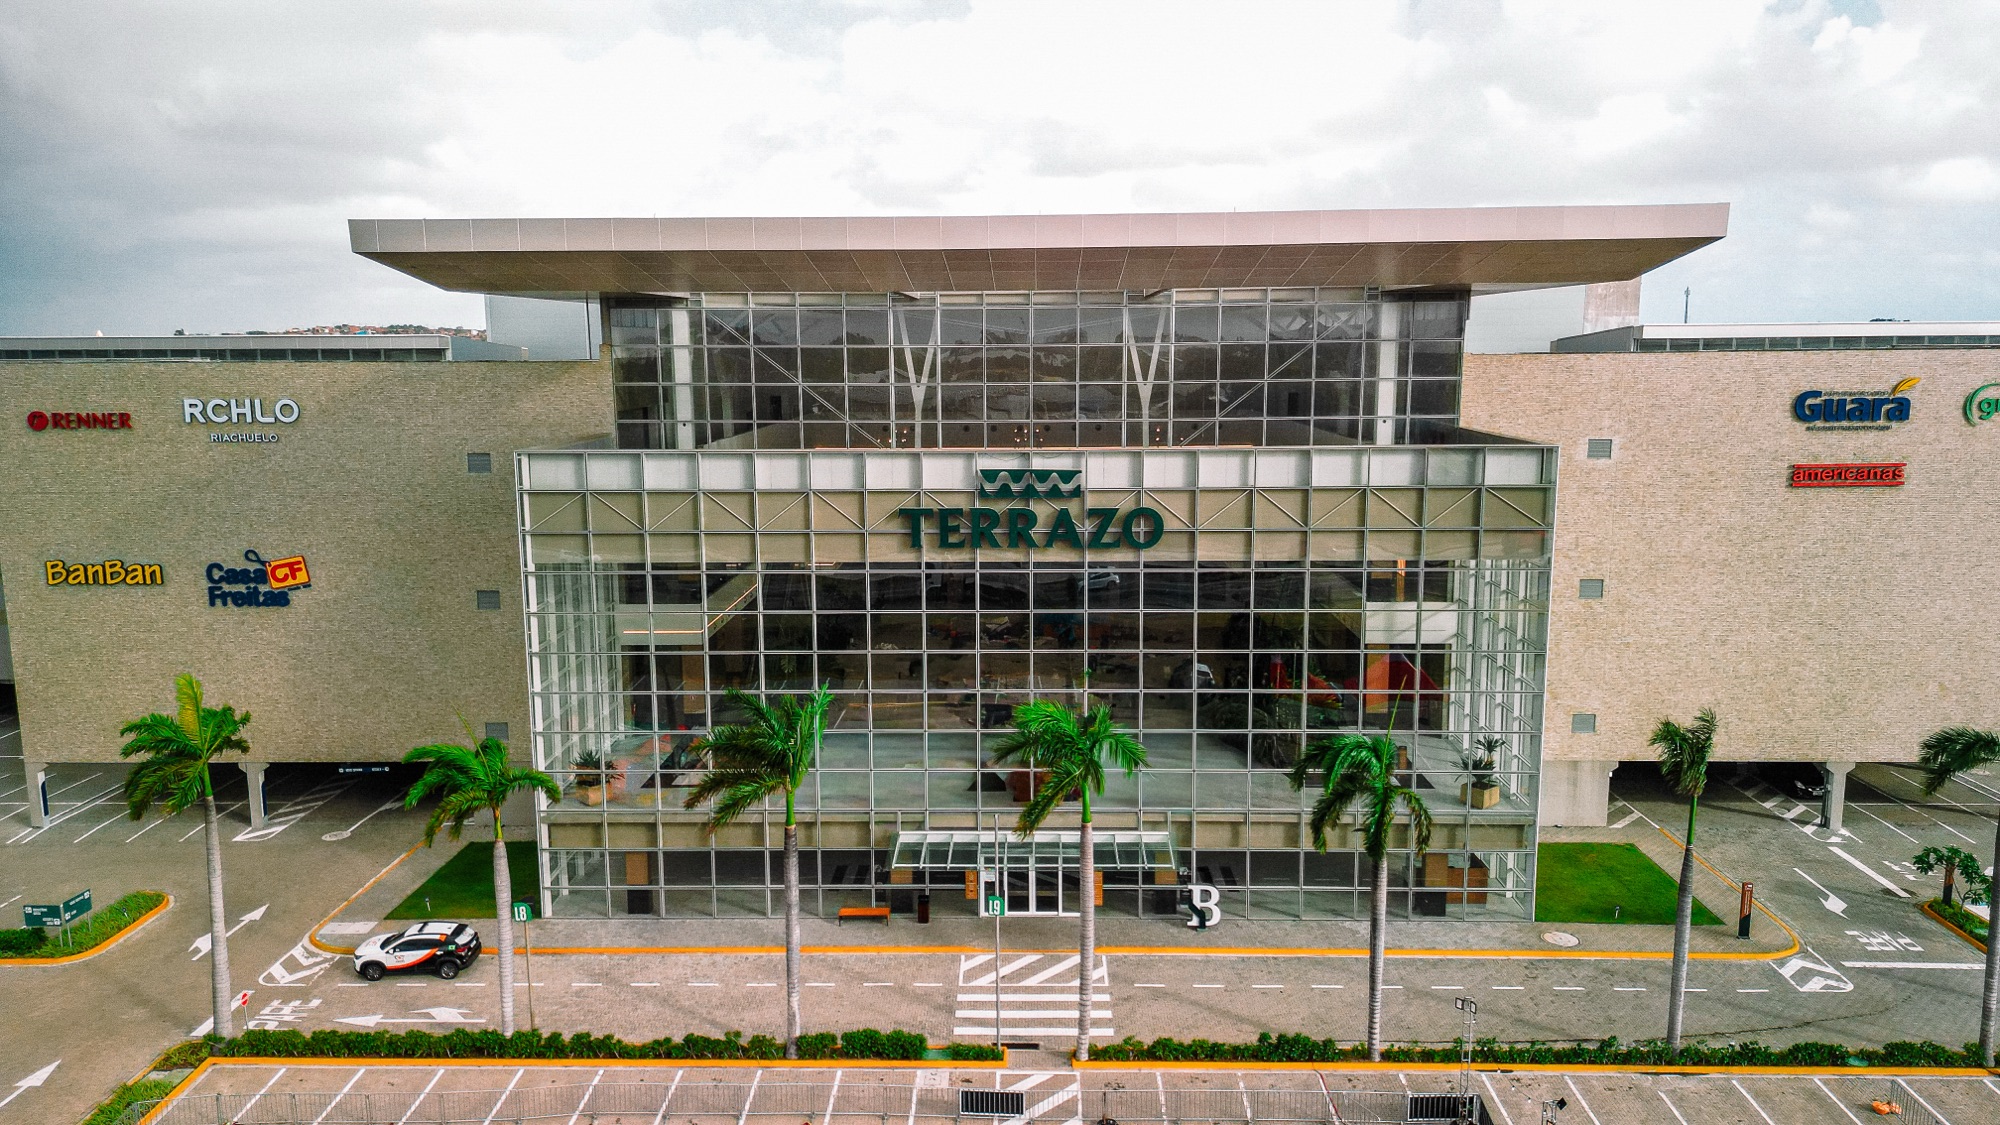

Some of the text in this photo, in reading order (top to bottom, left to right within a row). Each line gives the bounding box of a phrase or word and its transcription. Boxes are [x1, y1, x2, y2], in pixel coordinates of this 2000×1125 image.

[51, 412, 133, 430] RENNER
[183, 398, 300, 424] RCHLO
[210, 433, 279, 442] RIACHUELO
[1793, 467, 1905, 481] americanas
[898, 507, 1164, 549] TERRAZO
[46, 560, 163, 585] BanBan
[206, 560, 303, 584] Casa CF
[208, 585, 290, 607] Freitas
[514, 906, 527, 921] L8
[1844, 930, 1925, 951] PARE
